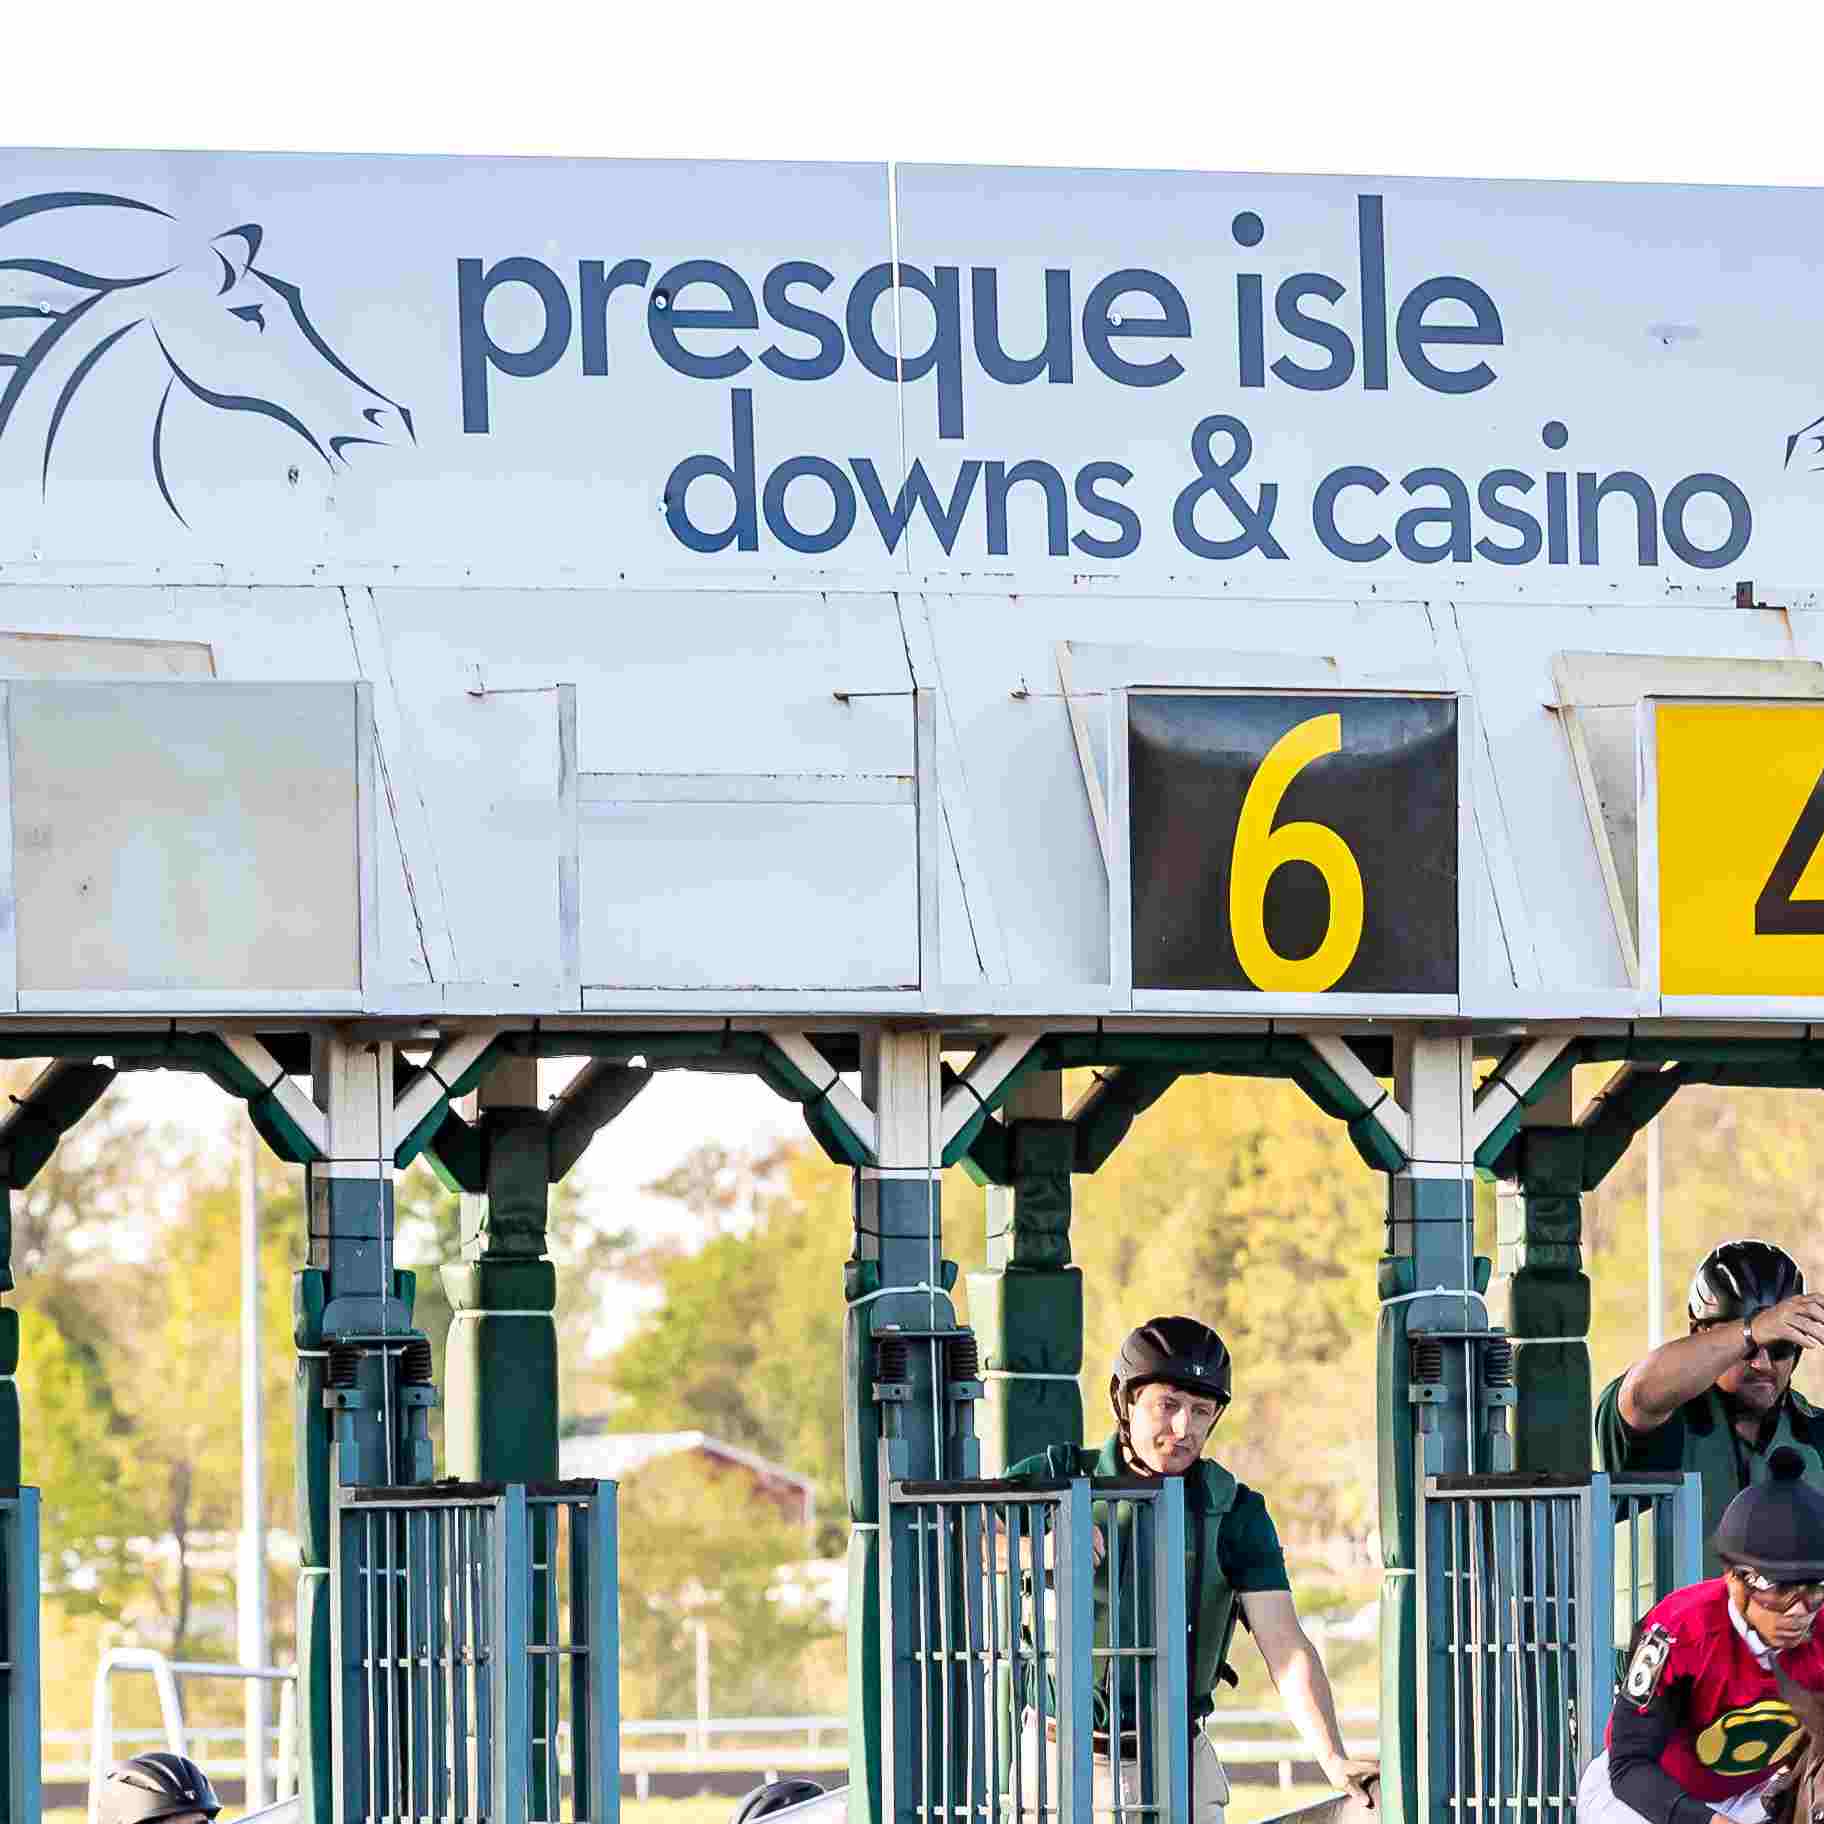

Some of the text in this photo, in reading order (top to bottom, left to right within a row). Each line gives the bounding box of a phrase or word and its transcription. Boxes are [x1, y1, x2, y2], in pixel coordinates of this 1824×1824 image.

[457, 193, 1505, 441] presque isle
[663, 387, 1753, 570] downs & casino
[1229, 714, 1365, 994] 6
[1627, 1643, 1663, 1697] 6
